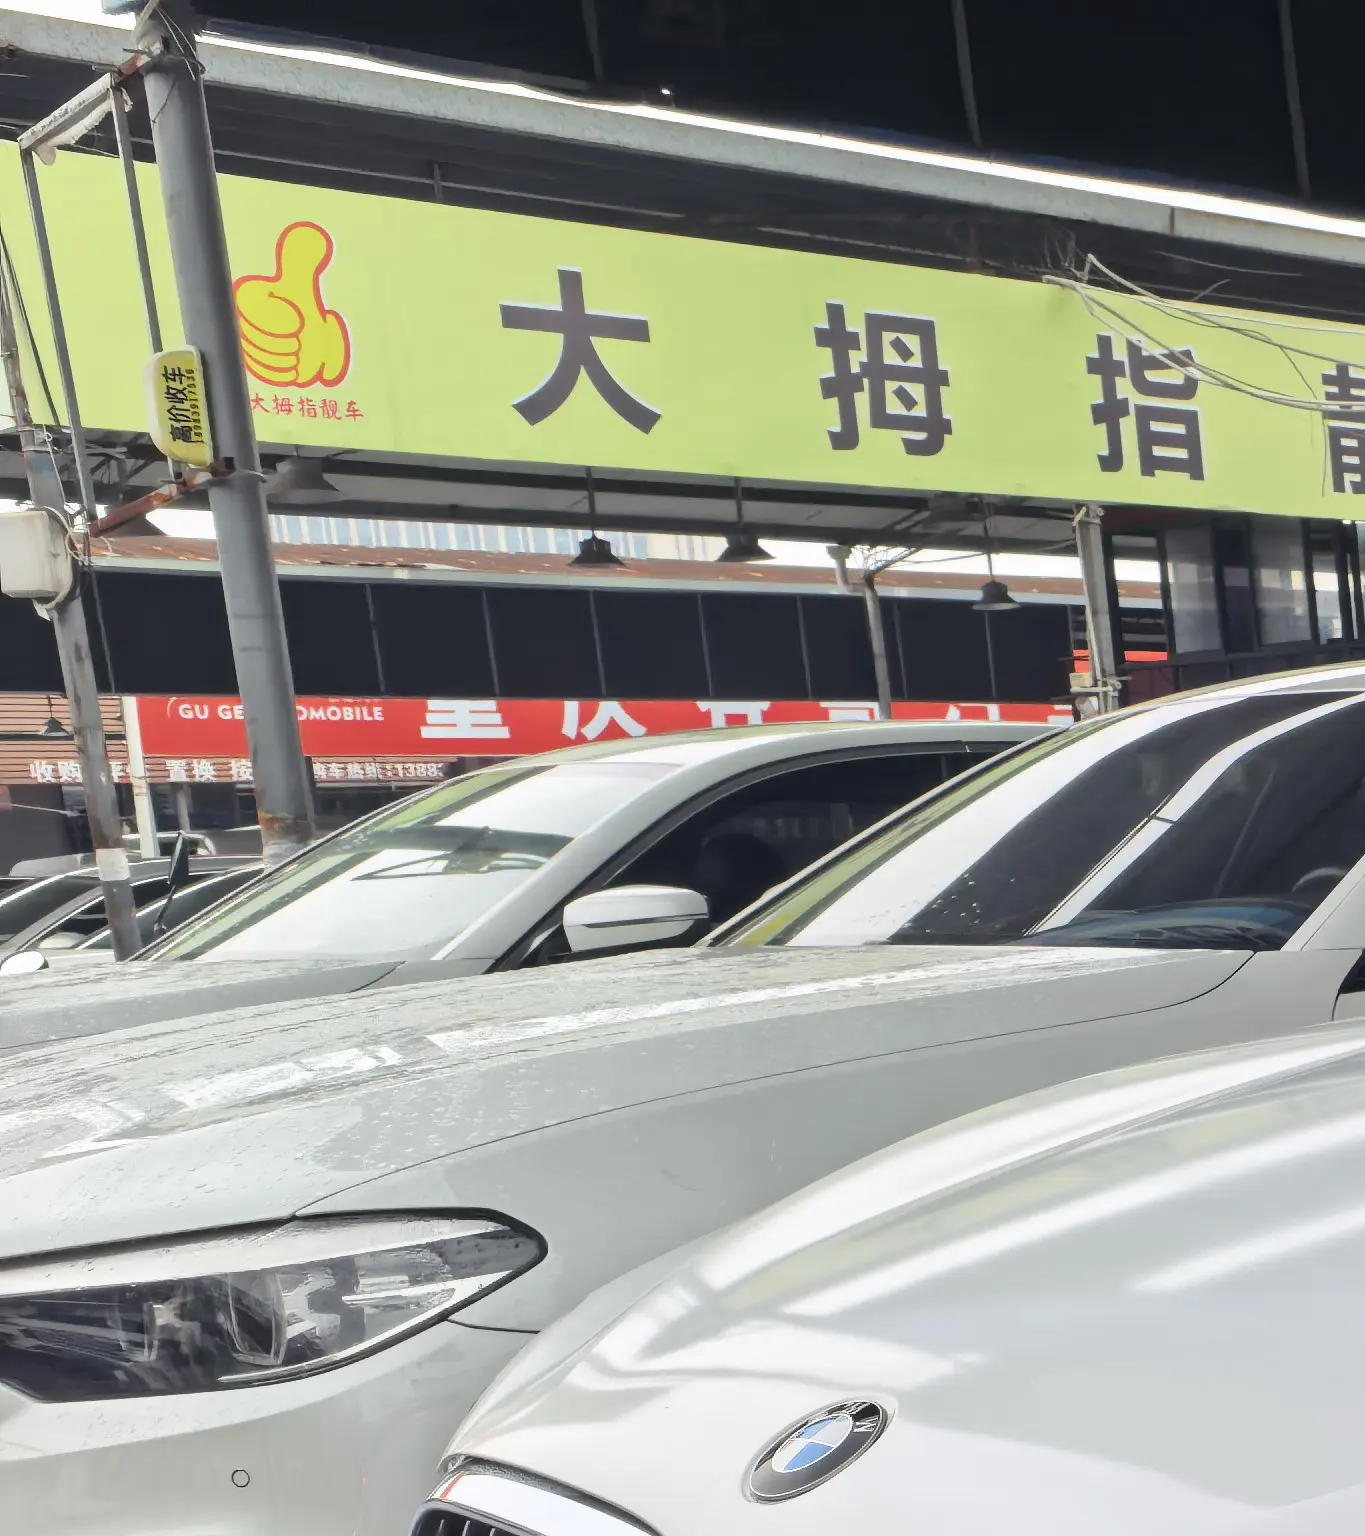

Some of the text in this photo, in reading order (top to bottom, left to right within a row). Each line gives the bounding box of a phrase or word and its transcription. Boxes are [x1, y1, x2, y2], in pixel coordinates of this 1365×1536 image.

[162, 365, 194, 443] 高价收车
[250, 392, 364, 422] 大拇指靓车
[178, 703, 209, 720] GU
[296, 705, 385, 722] OMOBILE
